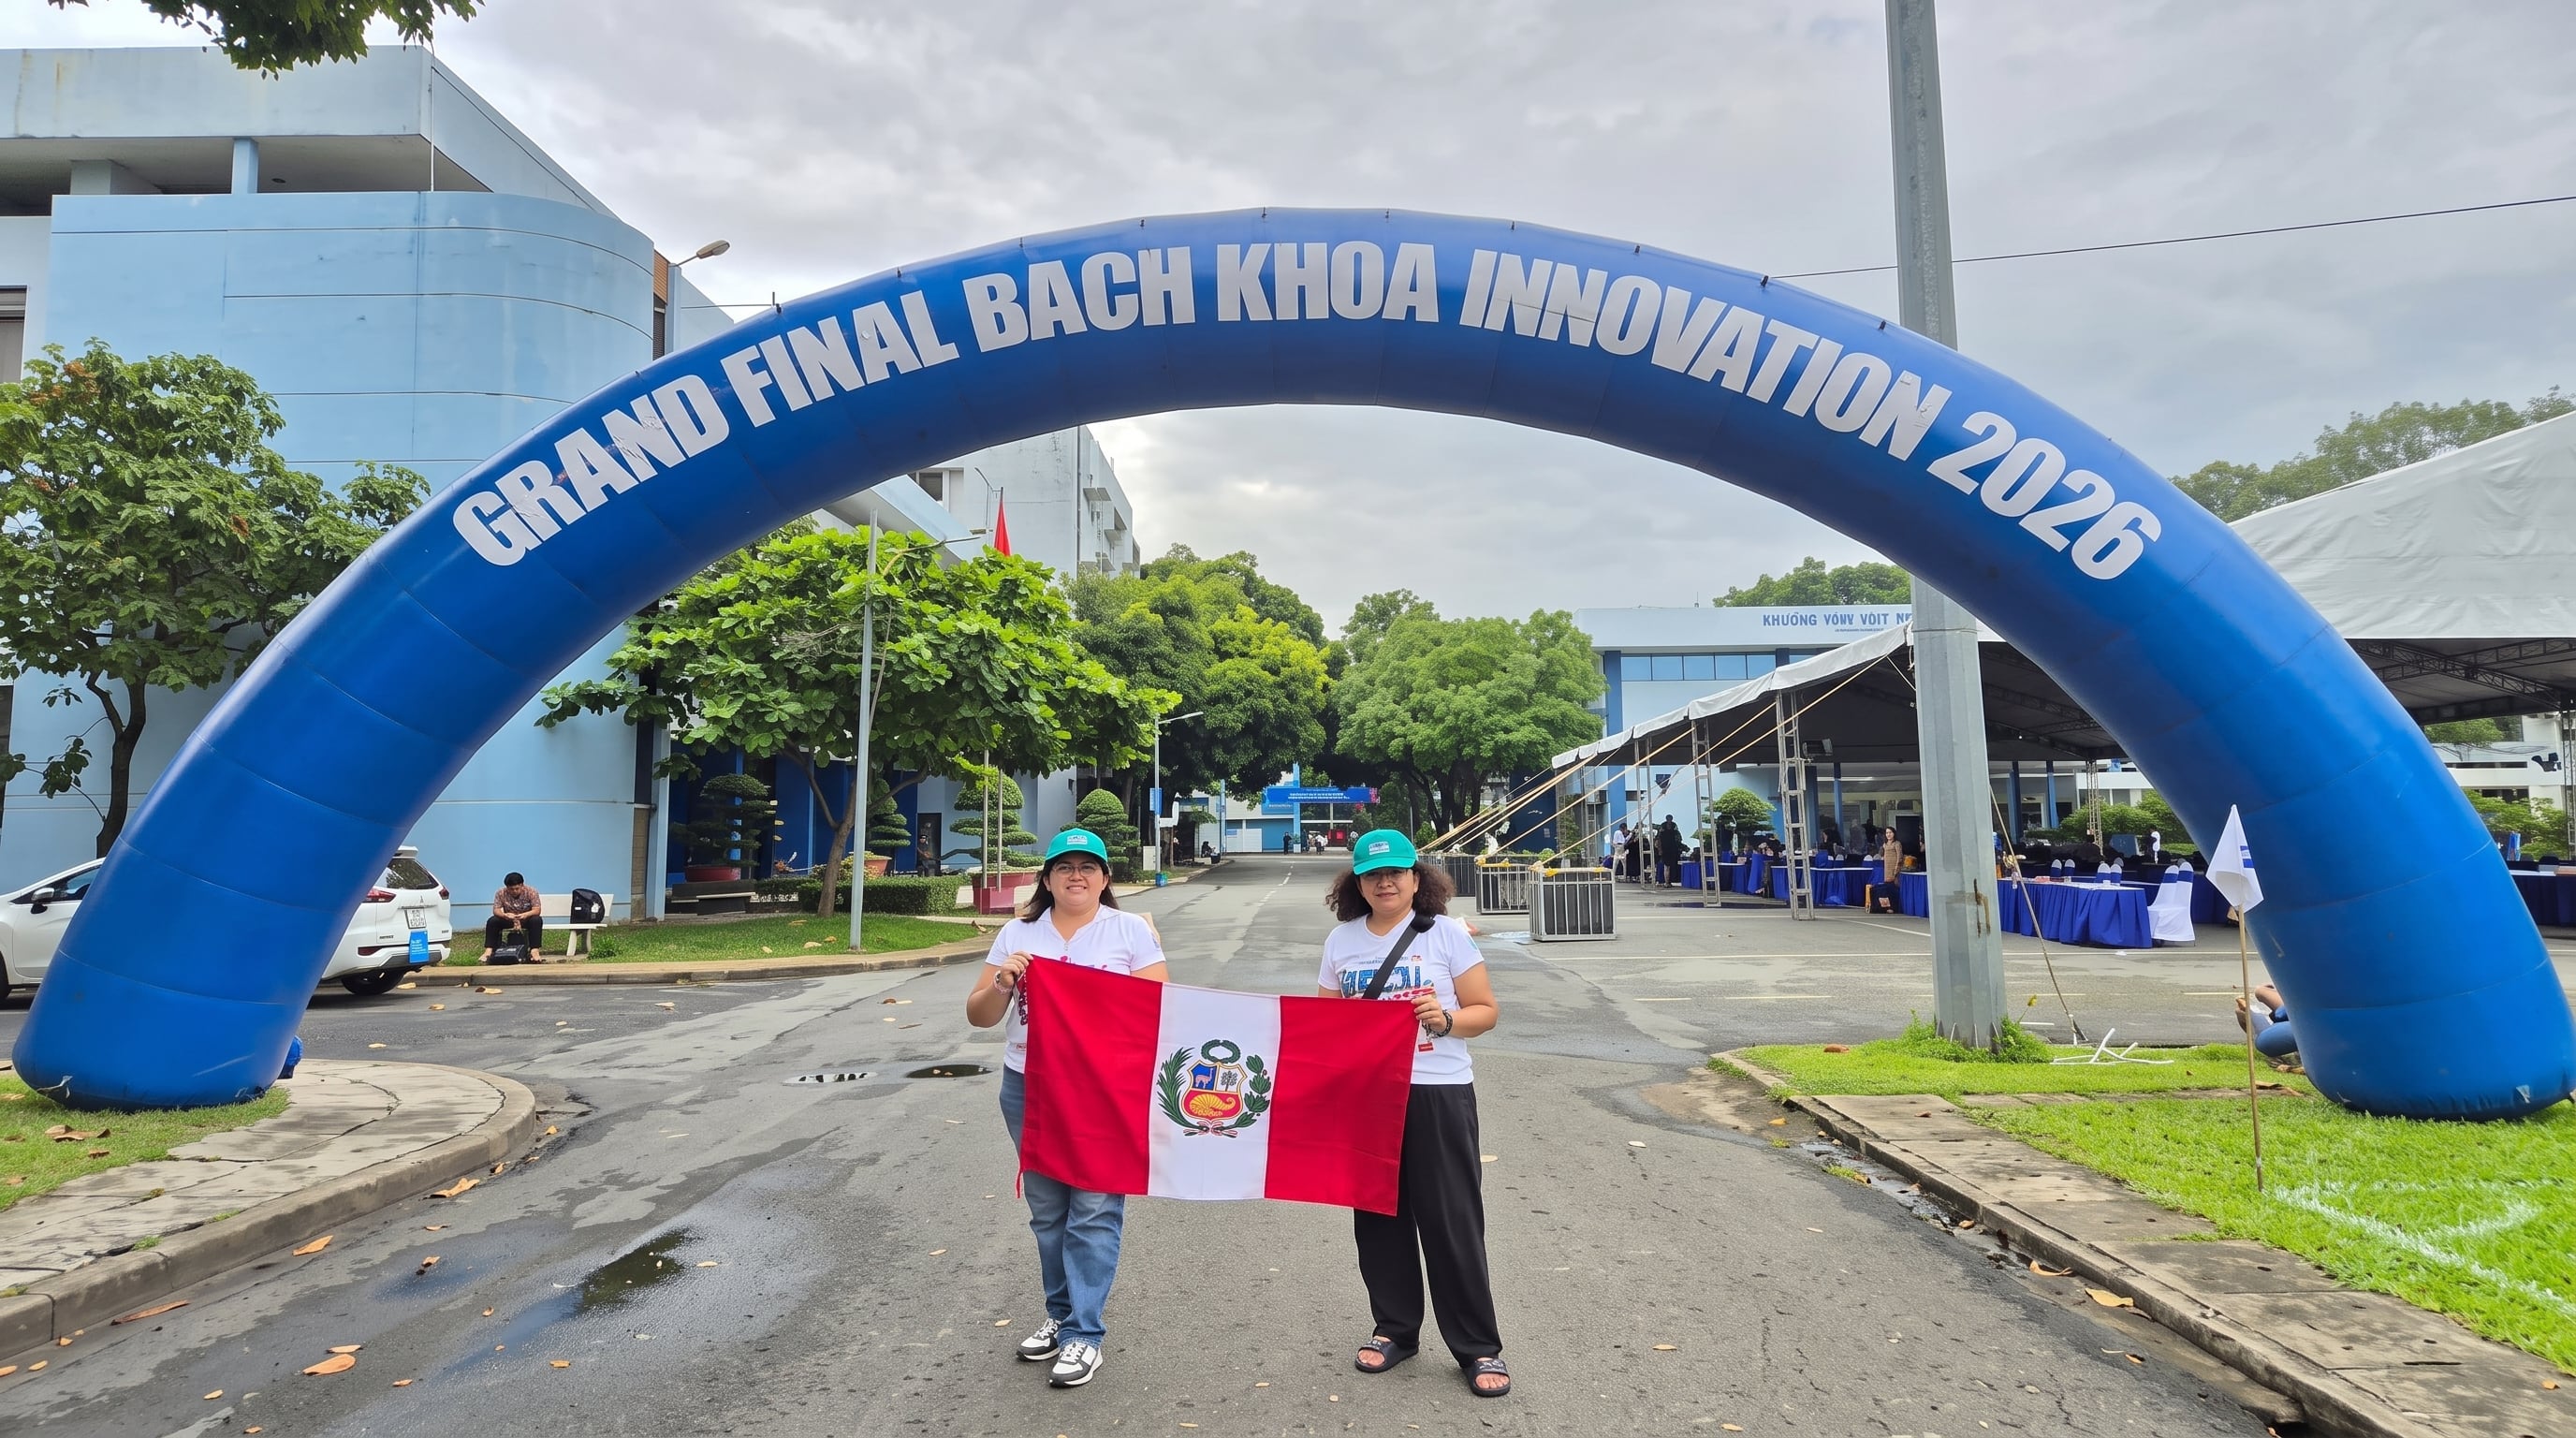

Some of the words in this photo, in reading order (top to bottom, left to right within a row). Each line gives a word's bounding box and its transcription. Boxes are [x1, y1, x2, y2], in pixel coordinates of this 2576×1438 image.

[452, 374, 730, 566] GRAND
[721, 290, 959, 428] FINAL
[962, 246, 1195, 353] BACH
[1216, 241, 1440, 323] KHOA
[1458, 248, 1952, 462] INNOVATION
[1926, 411, 2161, 580] 2026
